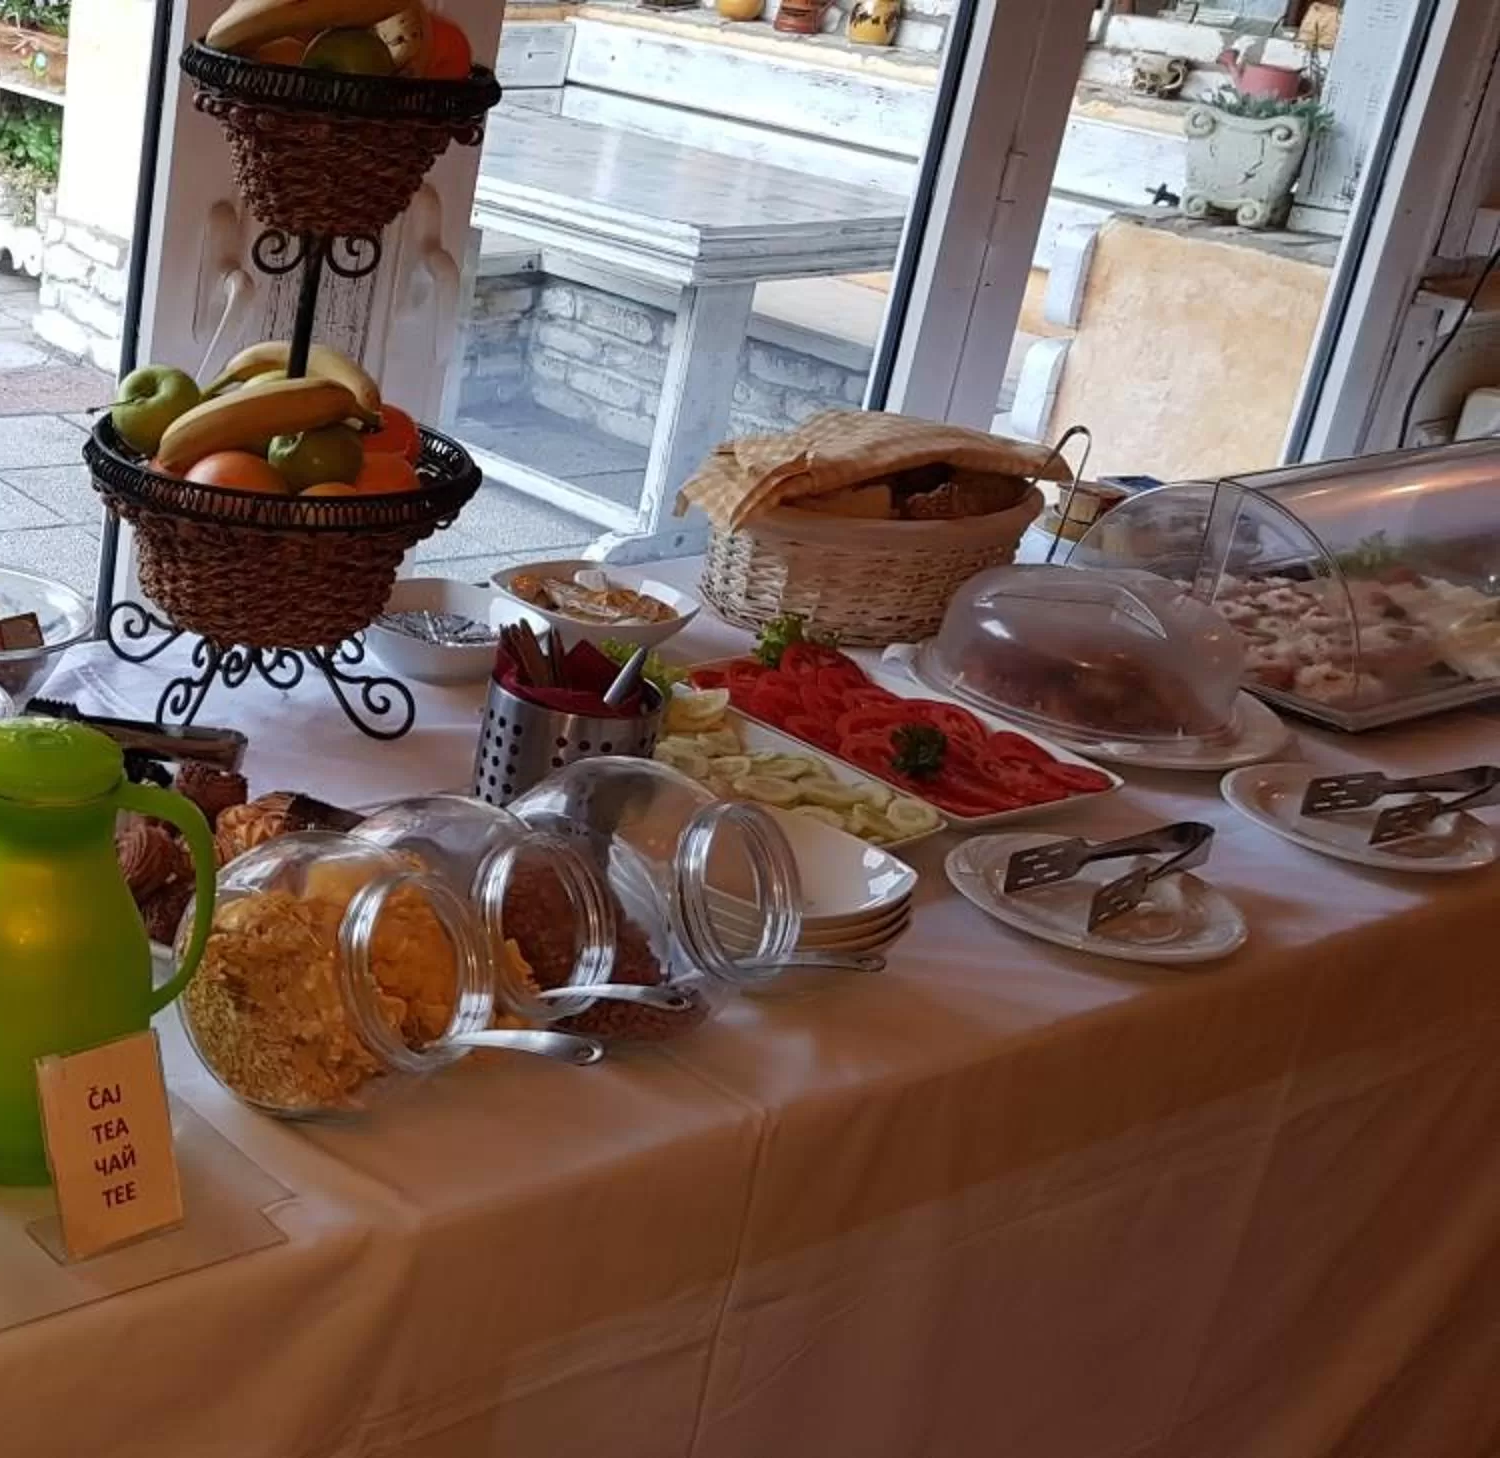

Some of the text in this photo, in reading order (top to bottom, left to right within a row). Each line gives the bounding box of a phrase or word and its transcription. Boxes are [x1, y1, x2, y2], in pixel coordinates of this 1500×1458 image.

[87, 1083, 121, 1110] ČAJ
[91, 1117, 130, 1145] TEA
[94, 1143, 136, 1177] ЧАЙ
[102, 1181, 137, 1209] TEE
